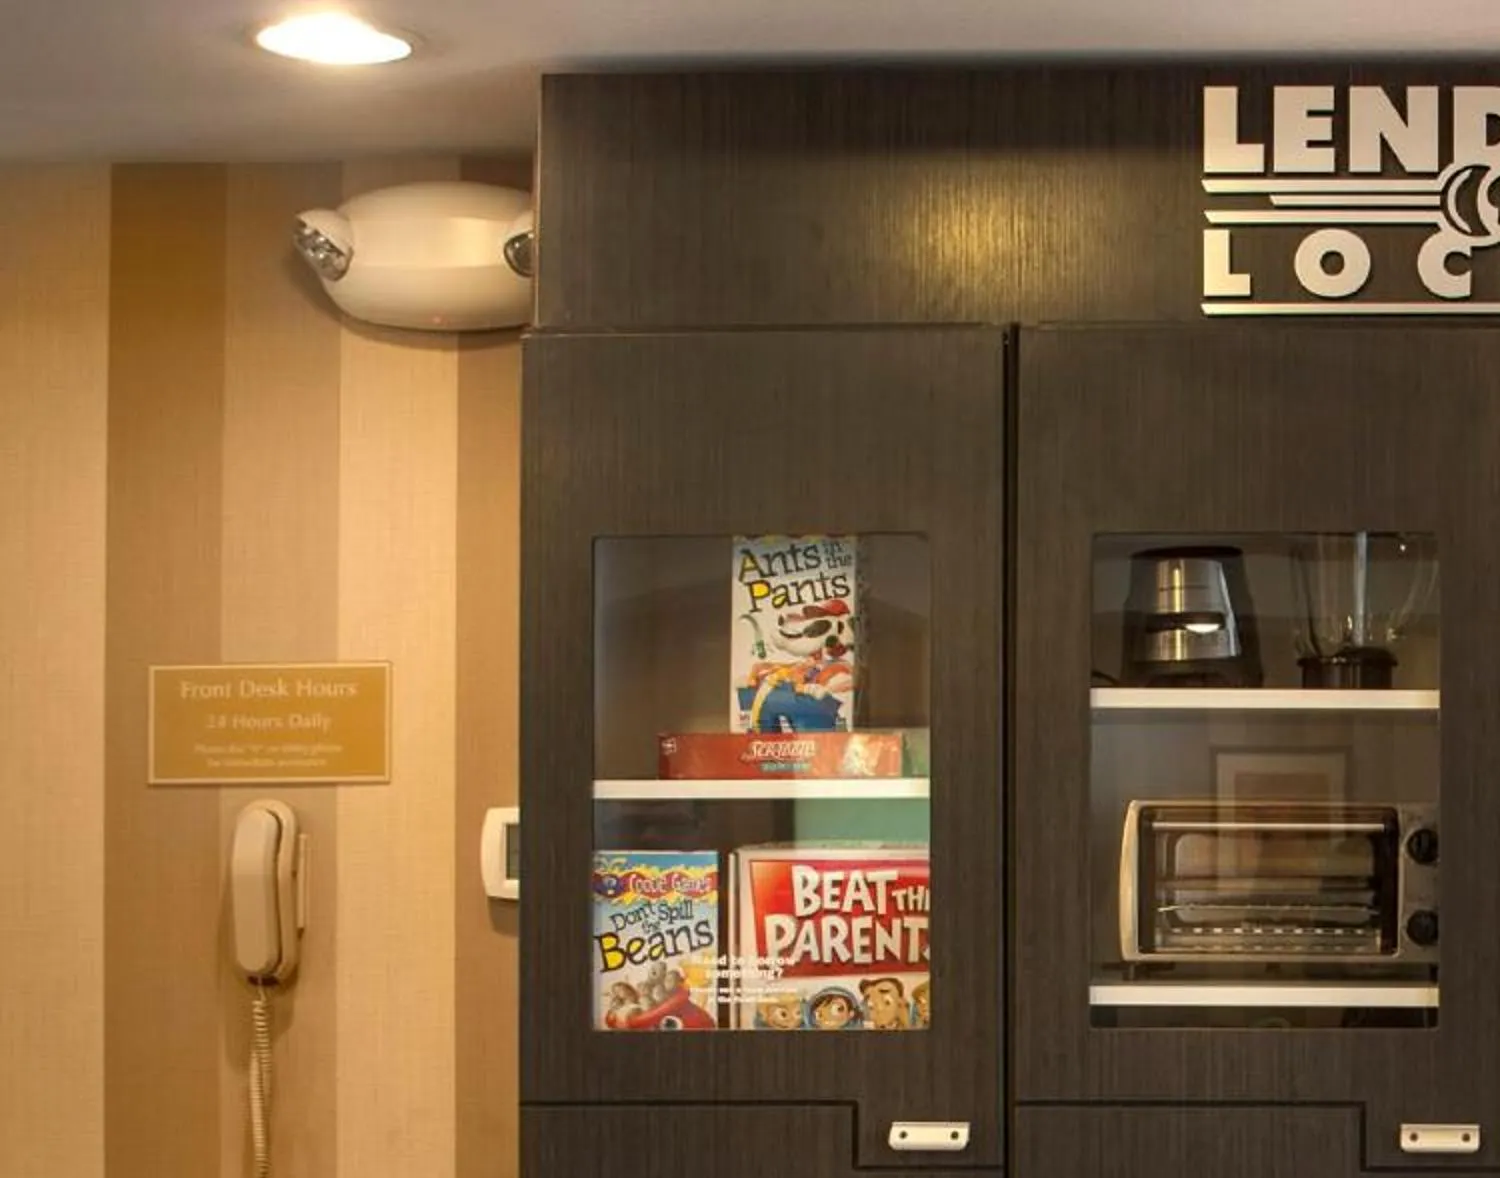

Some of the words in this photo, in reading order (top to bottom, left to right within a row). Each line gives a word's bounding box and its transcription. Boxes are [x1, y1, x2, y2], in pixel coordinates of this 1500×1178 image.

[738, 543, 821, 581] Ants
[743, 572, 850, 613] Pants
[180, 680, 231, 699] Front
[240, 677, 288, 698] Desk
[296, 678, 359, 698] Hours
[232, 714, 284, 730] Hours
[289, 713, 332, 734] Daily
[791, 864, 899, 917] BEAT
[658, 899, 694, 924] Spill
[593, 919, 714, 973] Beans
[764, 914, 931, 964] PARENT
